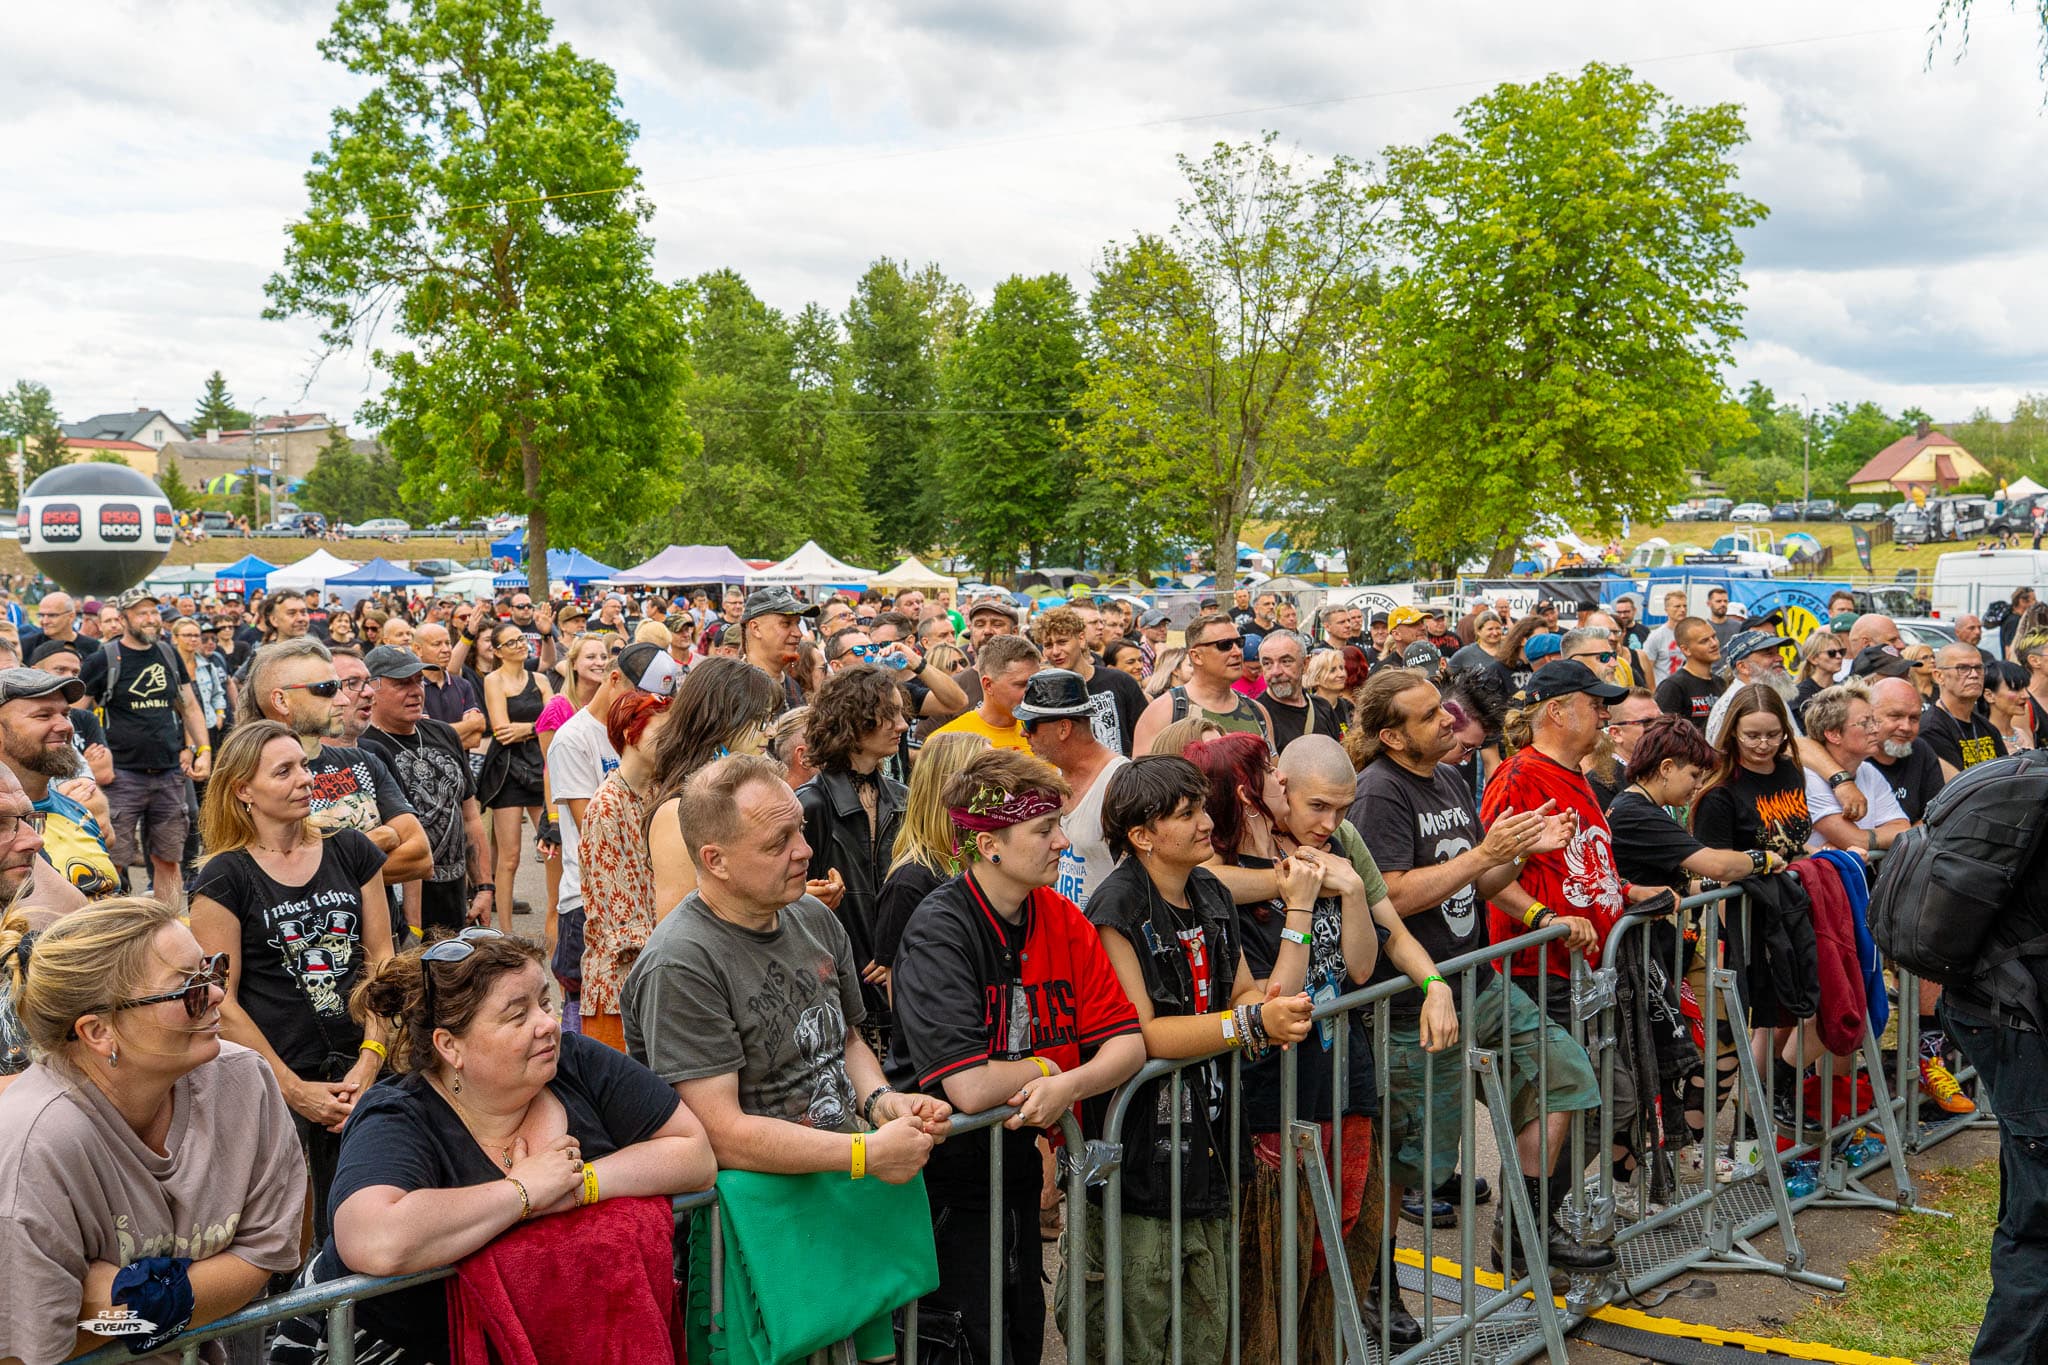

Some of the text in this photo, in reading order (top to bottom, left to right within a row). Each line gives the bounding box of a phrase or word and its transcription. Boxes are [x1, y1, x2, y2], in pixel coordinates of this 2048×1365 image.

[42, 525, 80, 537] ROCK
[101, 525, 140, 537] ROCK
[1366, 596, 1394, 612] PRZE
[1406, 653, 1432, 667] GULCH
[311, 889, 357, 907] lehre
